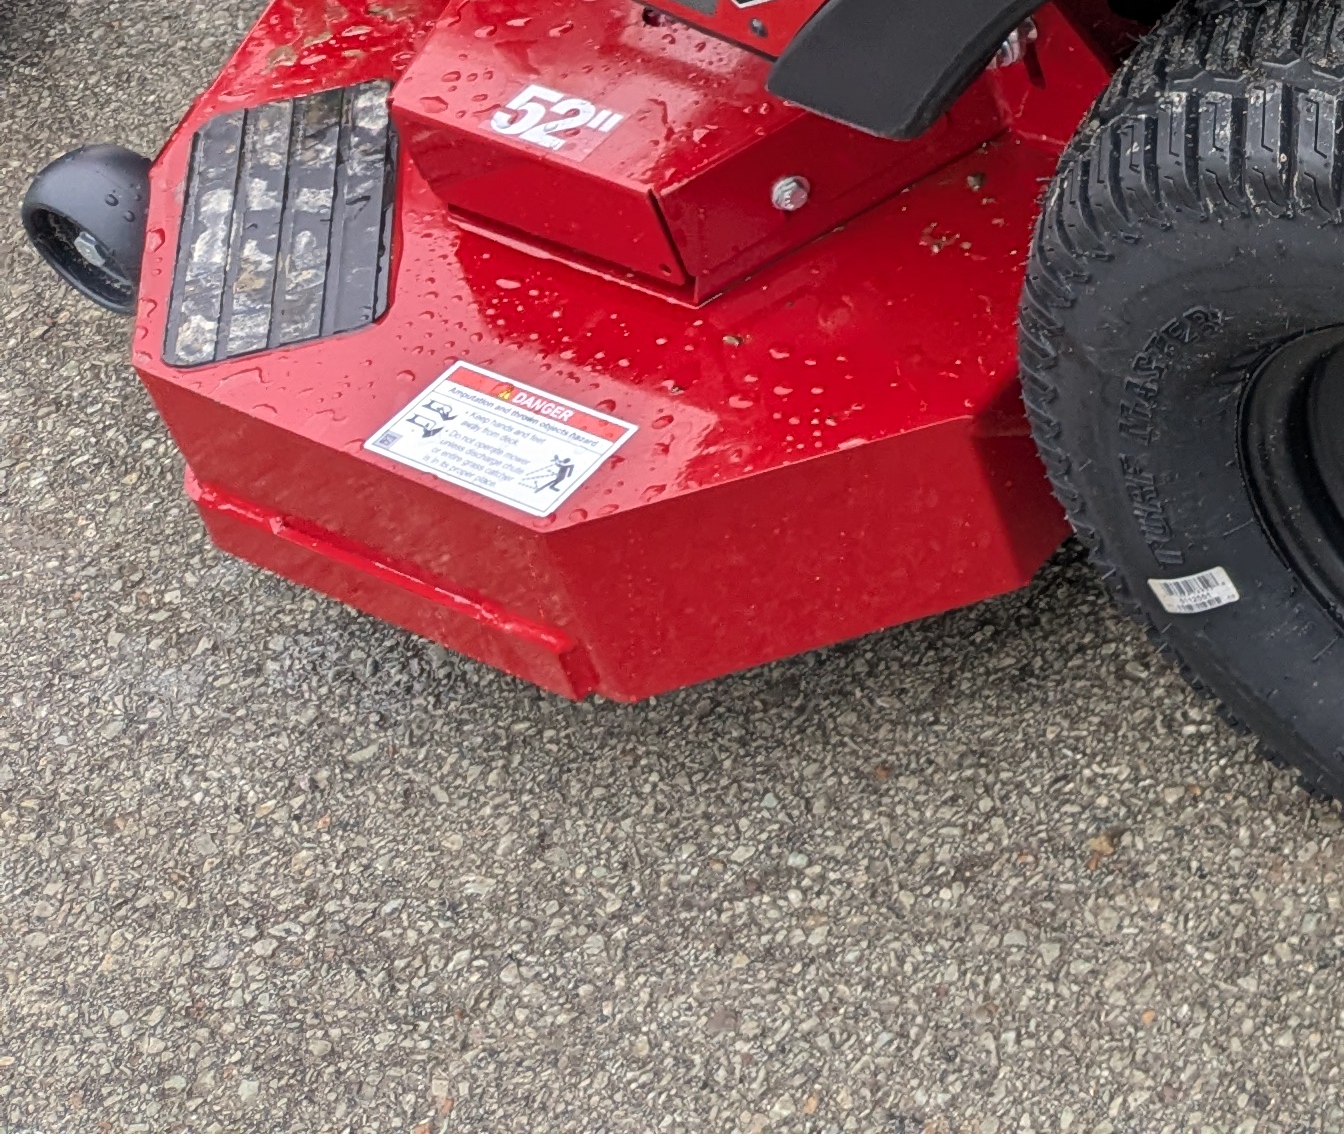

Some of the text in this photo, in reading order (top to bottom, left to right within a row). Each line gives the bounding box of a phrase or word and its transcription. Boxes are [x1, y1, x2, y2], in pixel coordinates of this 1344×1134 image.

[489, 84, 625, 149] 52"
[449, 387, 599, 447] Amputation and thrown objects hazard
[512, 392, 574, 422] DANGER
[460, 421, 482, 432] away
[482, 427, 500, 438] from
[470, 412, 547, 444] Keep hands and feet
[1118, 305, 1223, 569] TURF MASTER
[439, 439, 525, 475] unless discharge chute
[449, 429, 531, 465] Do not operate mower
[441, 451, 462, 463] entire
[463, 459, 485, 471] grass
[484, 466, 515, 482] catcher
[449, 465, 475, 478] proper
